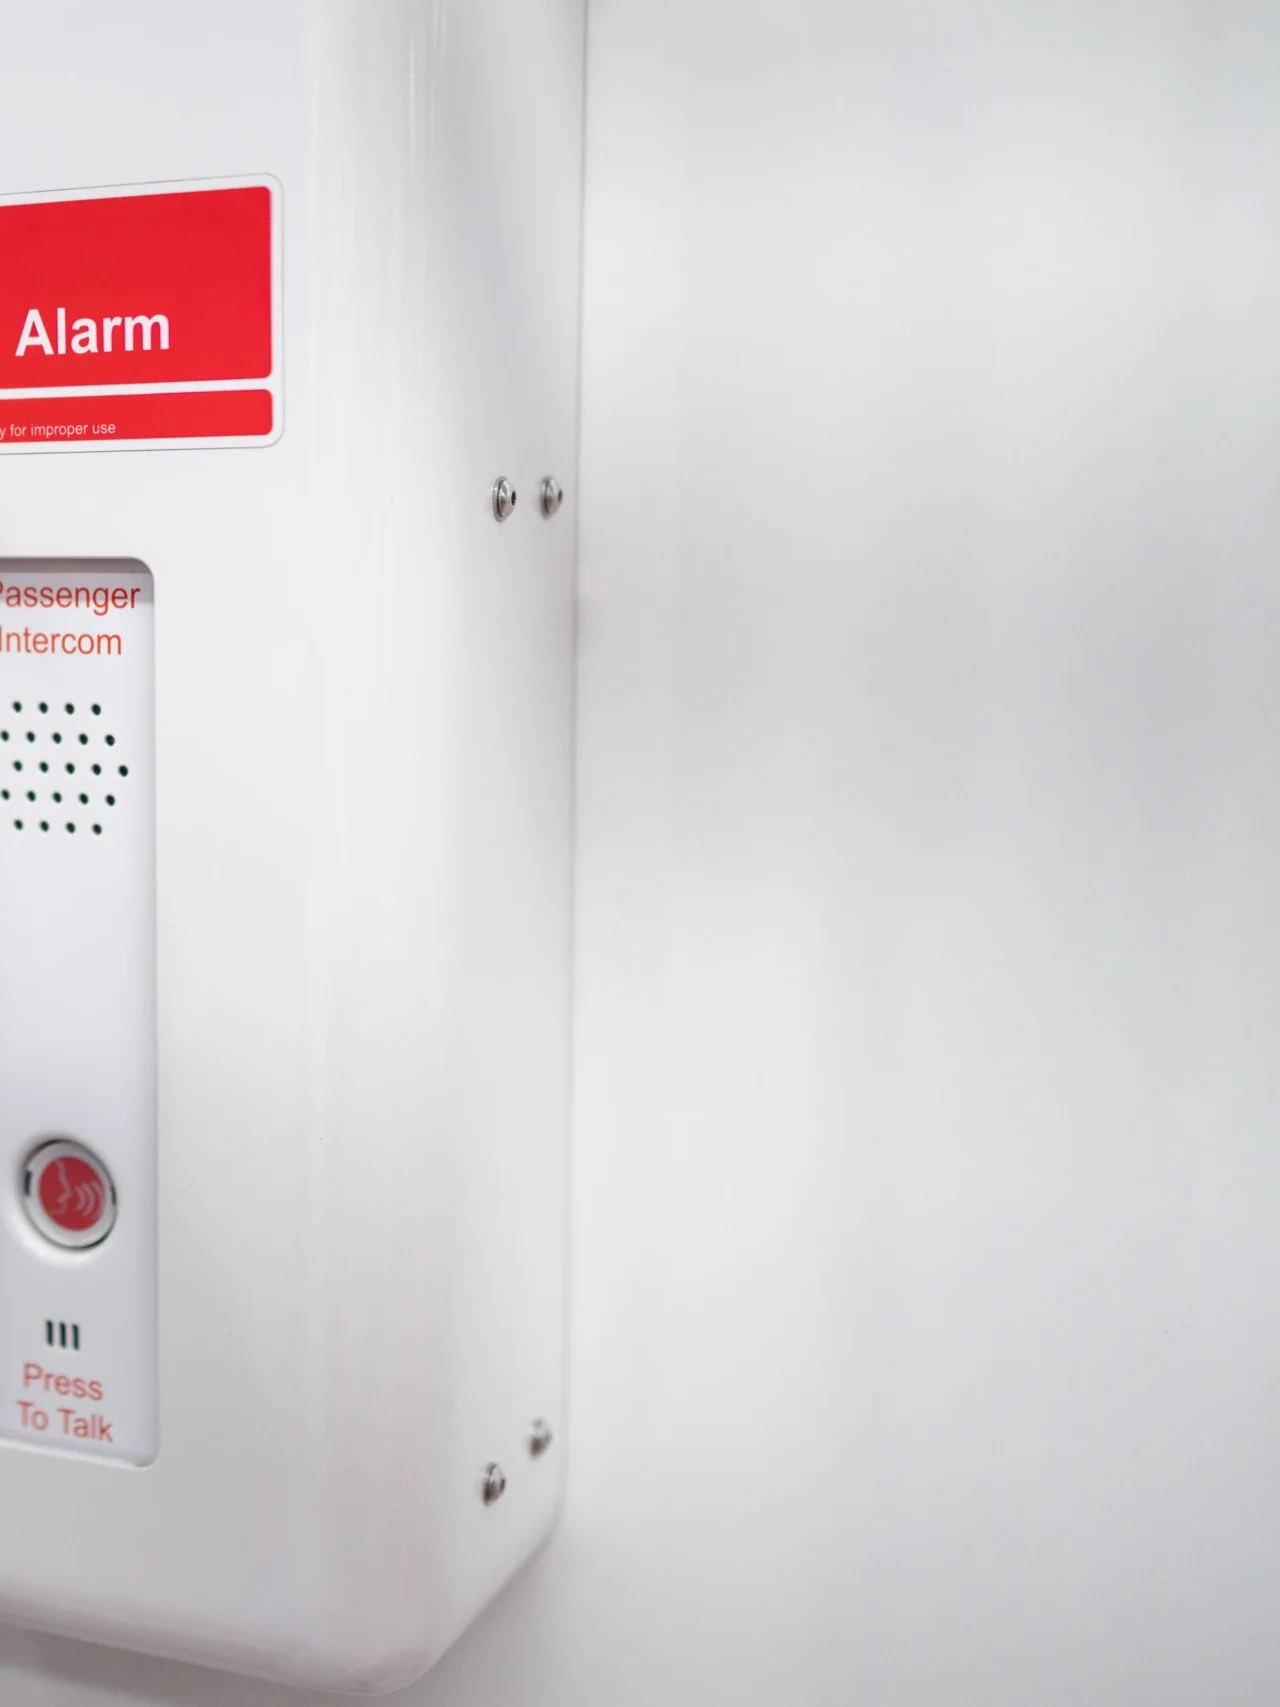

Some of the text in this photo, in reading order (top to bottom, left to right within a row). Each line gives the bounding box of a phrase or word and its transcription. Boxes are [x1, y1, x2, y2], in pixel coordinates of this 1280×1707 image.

[15, 307, 170, 357] Alarm
[10, 424, 27, 438] for
[30, 423, 88, 440] improper
[92, 423, 116, 435] use
[23, 1362, 104, 1401] Press
[16, 1400, 114, 1442] To Talk
